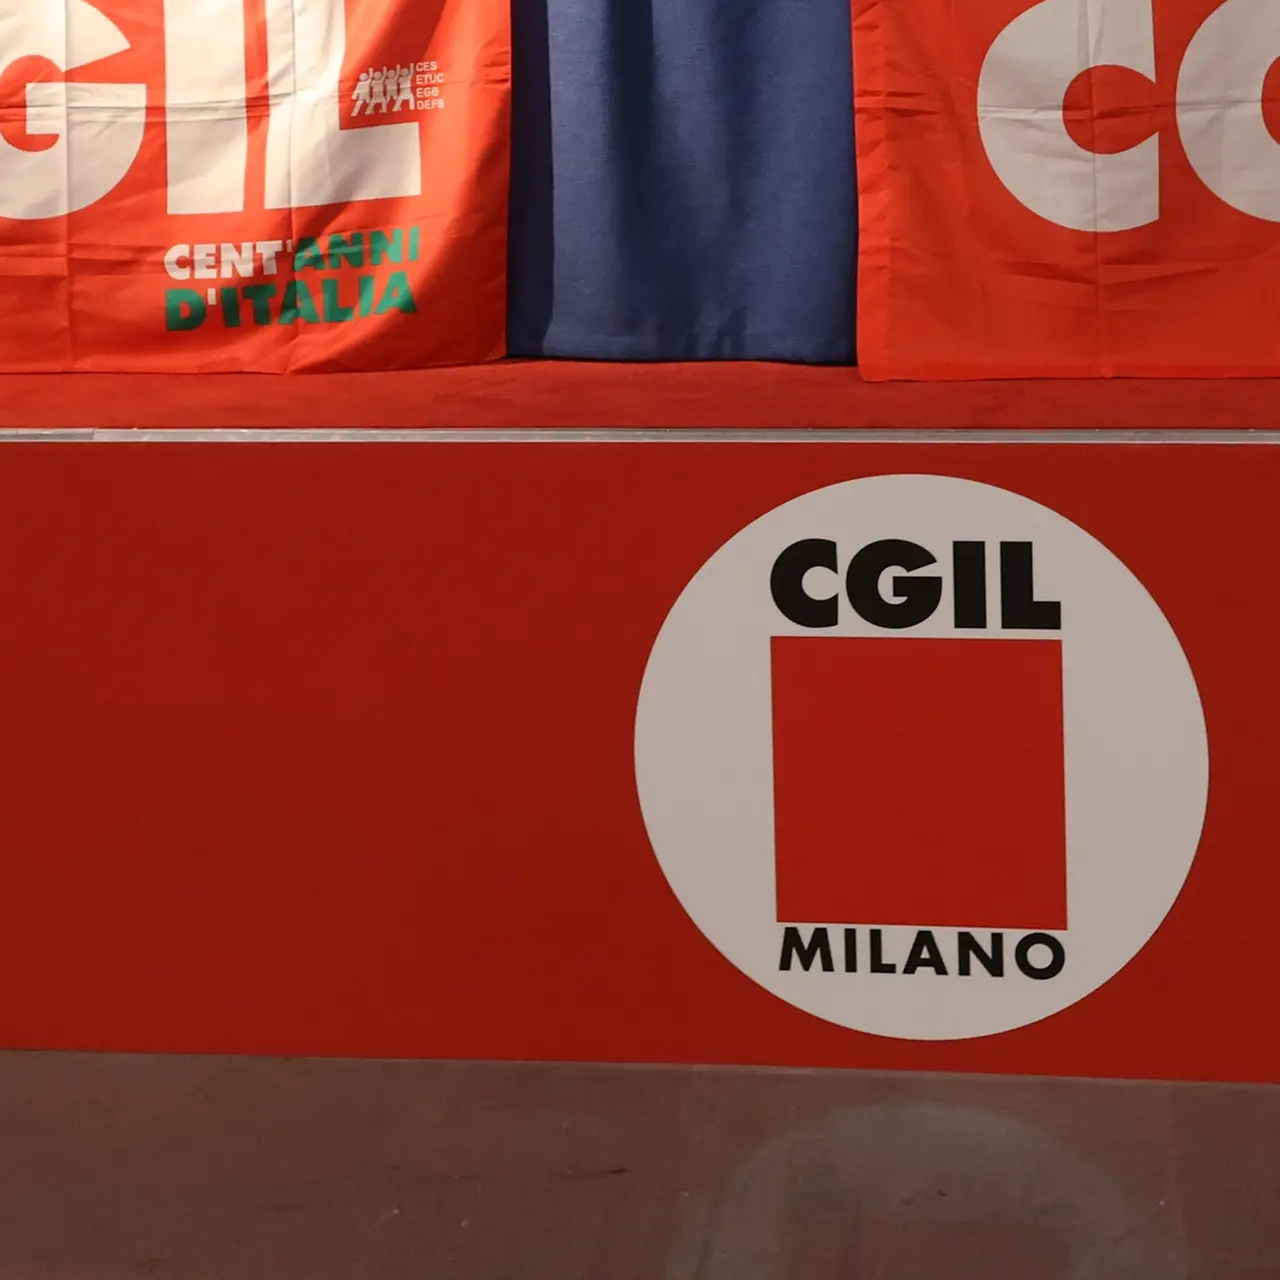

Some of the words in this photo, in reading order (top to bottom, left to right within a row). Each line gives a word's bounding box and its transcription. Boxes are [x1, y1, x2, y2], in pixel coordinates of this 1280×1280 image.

[416, 61, 438, 72] CES
[416, 73, 444, 85] ETUC
[416, 87, 439, 98] EGB
[164, 270, 418, 332] D'ITALIA
[770, 538, 1062, 630] CGIL
[778, 926, 1066, 980] MILANO
